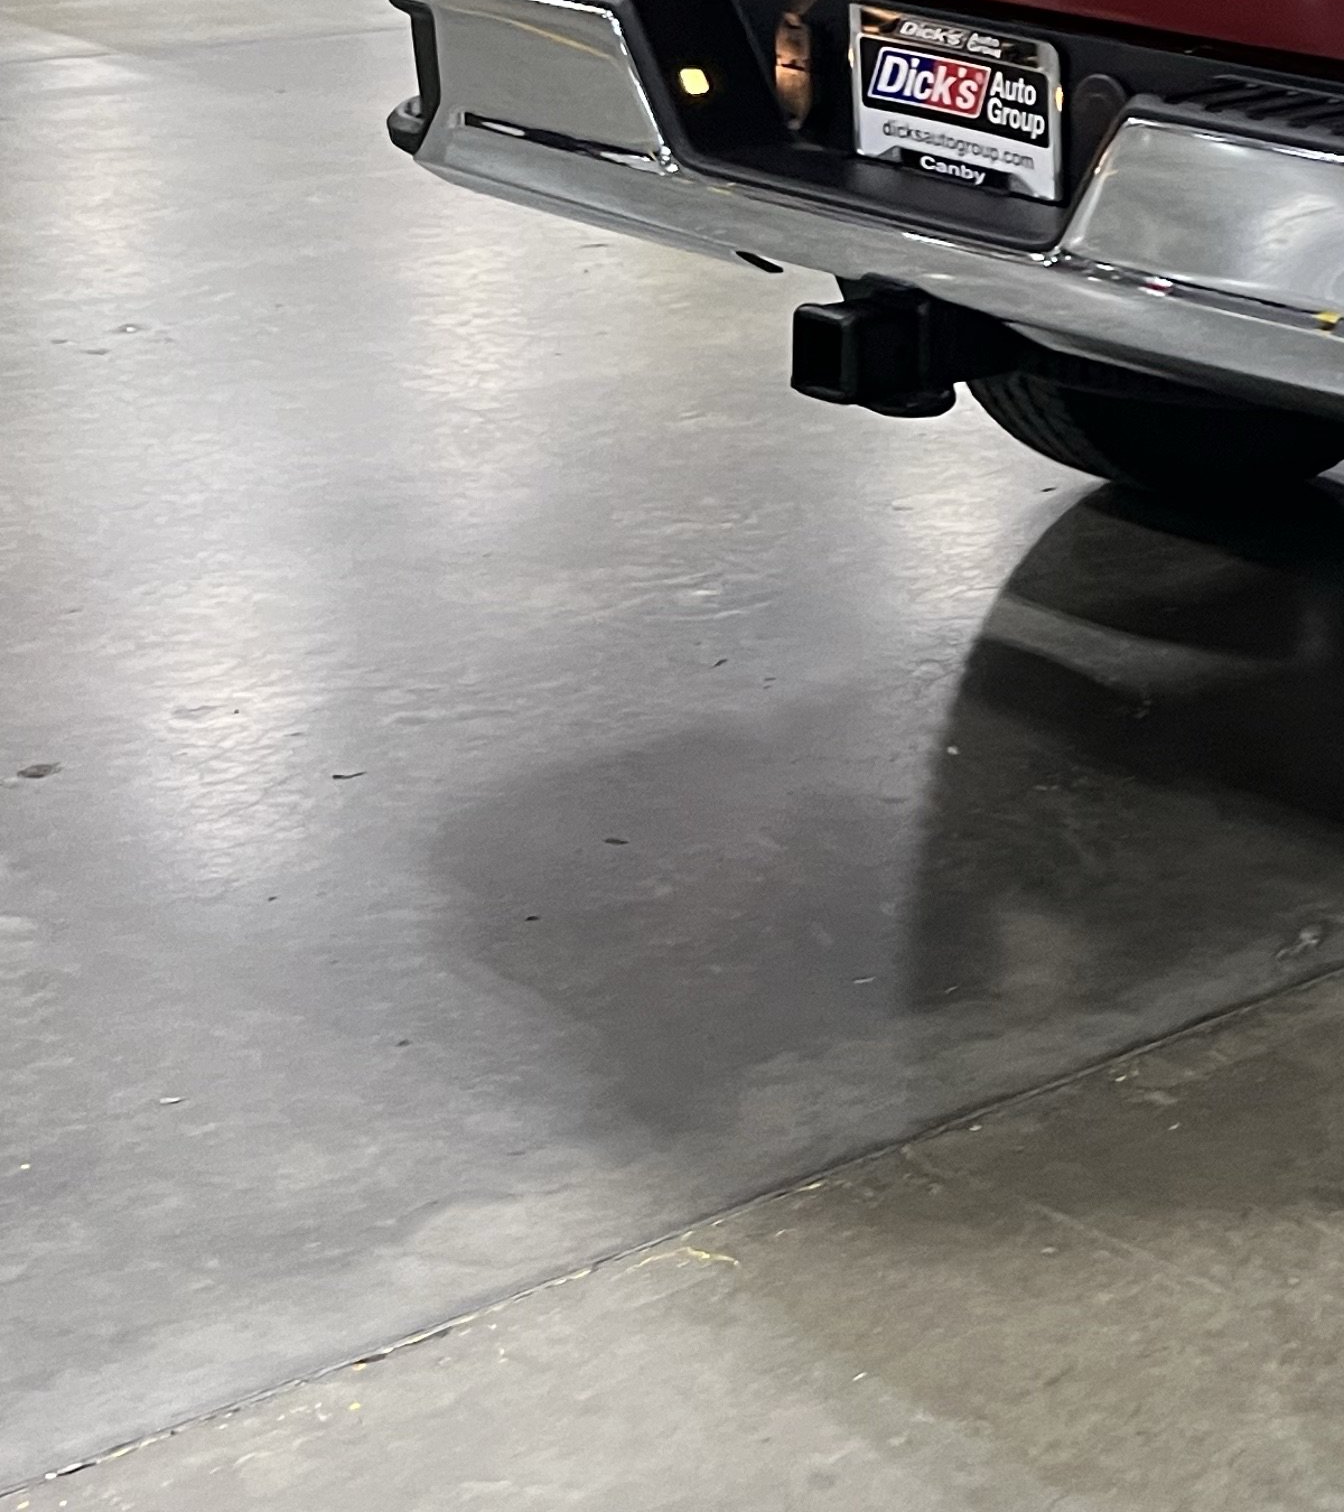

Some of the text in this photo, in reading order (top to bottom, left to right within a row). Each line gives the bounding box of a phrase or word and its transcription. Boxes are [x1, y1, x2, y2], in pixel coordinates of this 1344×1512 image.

[900, 21, 963, 47] Dick's
[876, 54, 979, 110] Dick's
[990, 71, 1037, 106] Auto
[987, 97, 1046, 139] Group
[883, 119, 1035, 170] dicksautogroup.com
[919, 155, 986, 186] Canby
